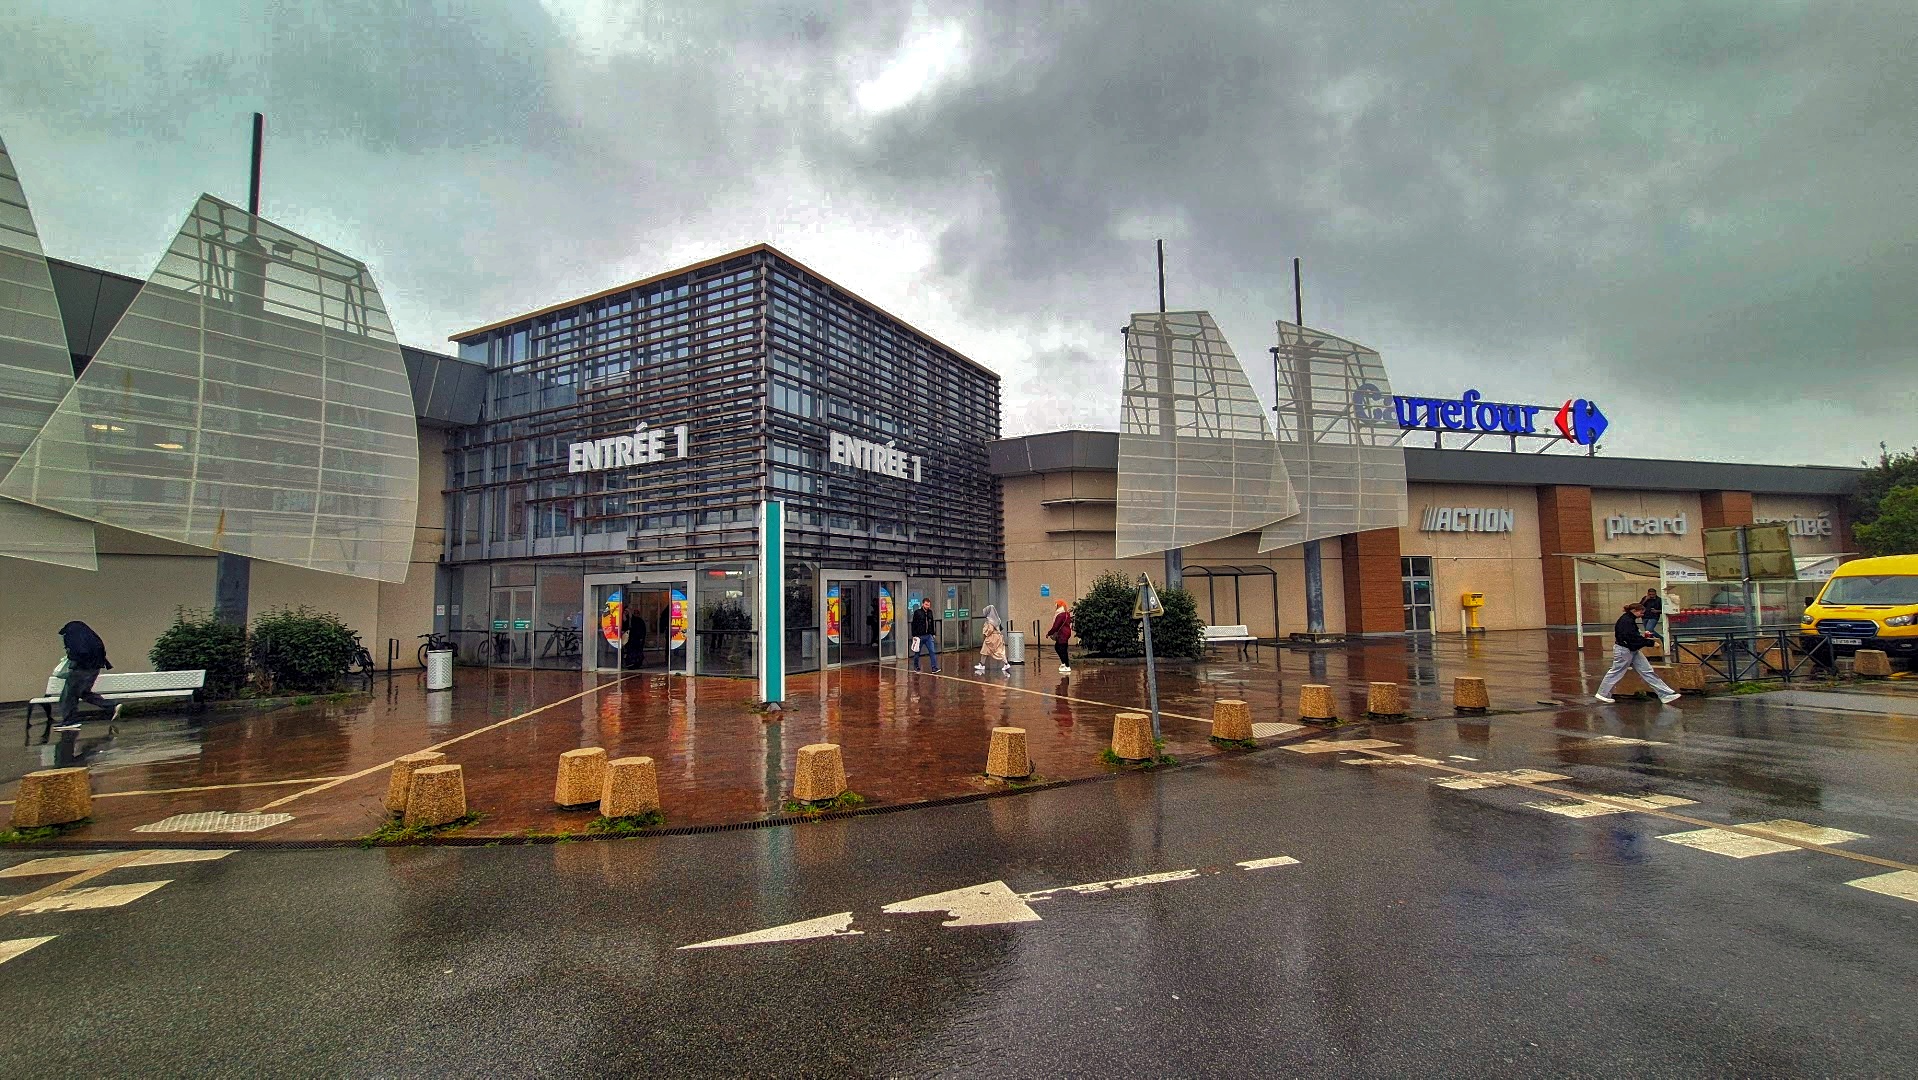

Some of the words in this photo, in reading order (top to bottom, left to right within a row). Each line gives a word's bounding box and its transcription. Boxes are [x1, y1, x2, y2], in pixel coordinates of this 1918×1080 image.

[1353, 382, 1539, 433] Carrefour
[568, 421, 666, 474] ENTRÉE
[673, 425, 689, 459] 1
[829, 430, 908, 480] ENTRÉE
[911, 455, 922, 483] 1
[1436, 507, 1514, 532] ACTION
[1606, 512, 1687, 540] picard
